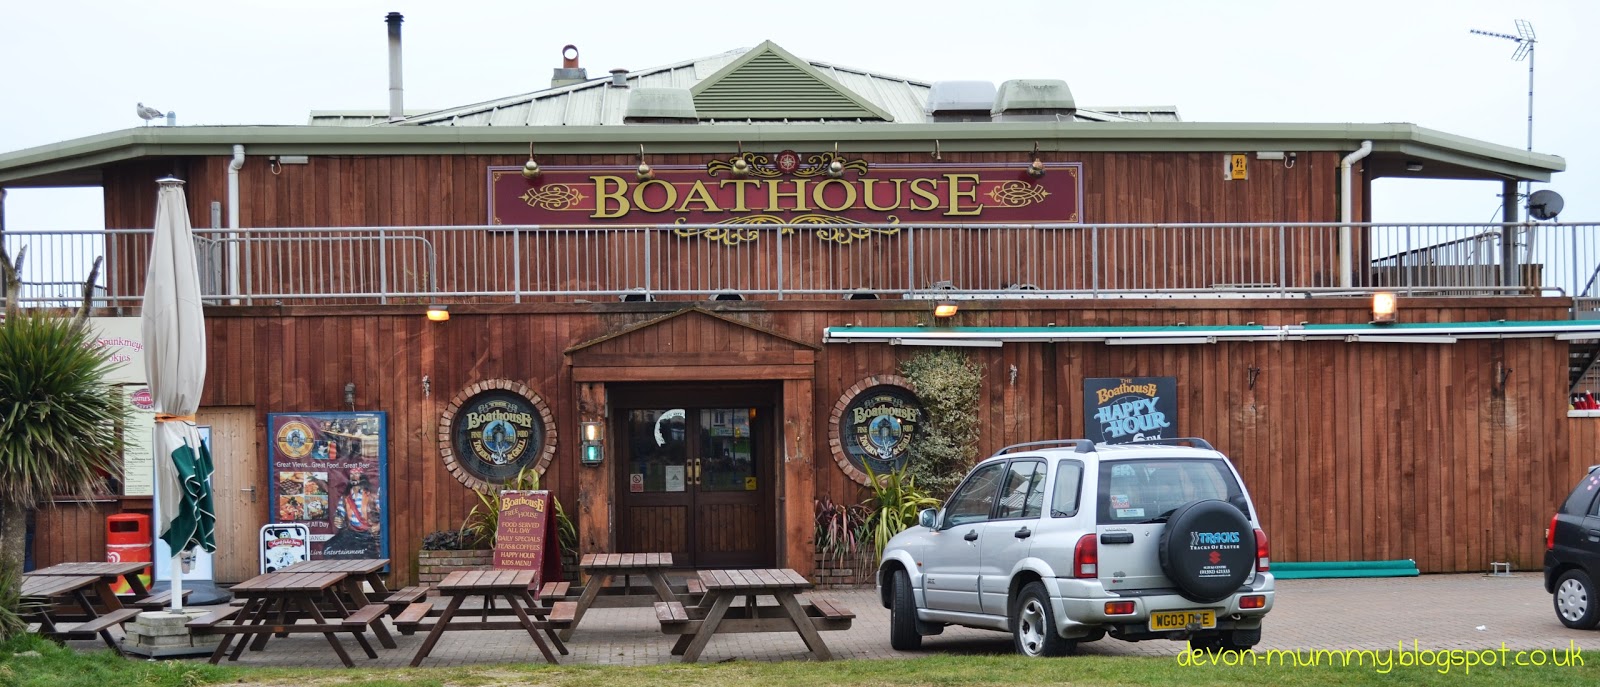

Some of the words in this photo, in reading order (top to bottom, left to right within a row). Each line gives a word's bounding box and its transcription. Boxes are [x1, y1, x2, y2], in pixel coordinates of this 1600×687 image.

[588, 173, 984, 219] BOATHOUSE
[1094, 397, 1160, 423] HAPPY
[1105, 412, 1170, 438] HOUR
[473, 440, 492, 461] TAVERN
[860, 434, 878, 456] TAVERN
[504, 508, 519, 516] FREE
[1199, 532, 1240, 544] TRACKS
[1156, 614, 1185, 627] WG03
[1188, 613, 1209, 625] DE
